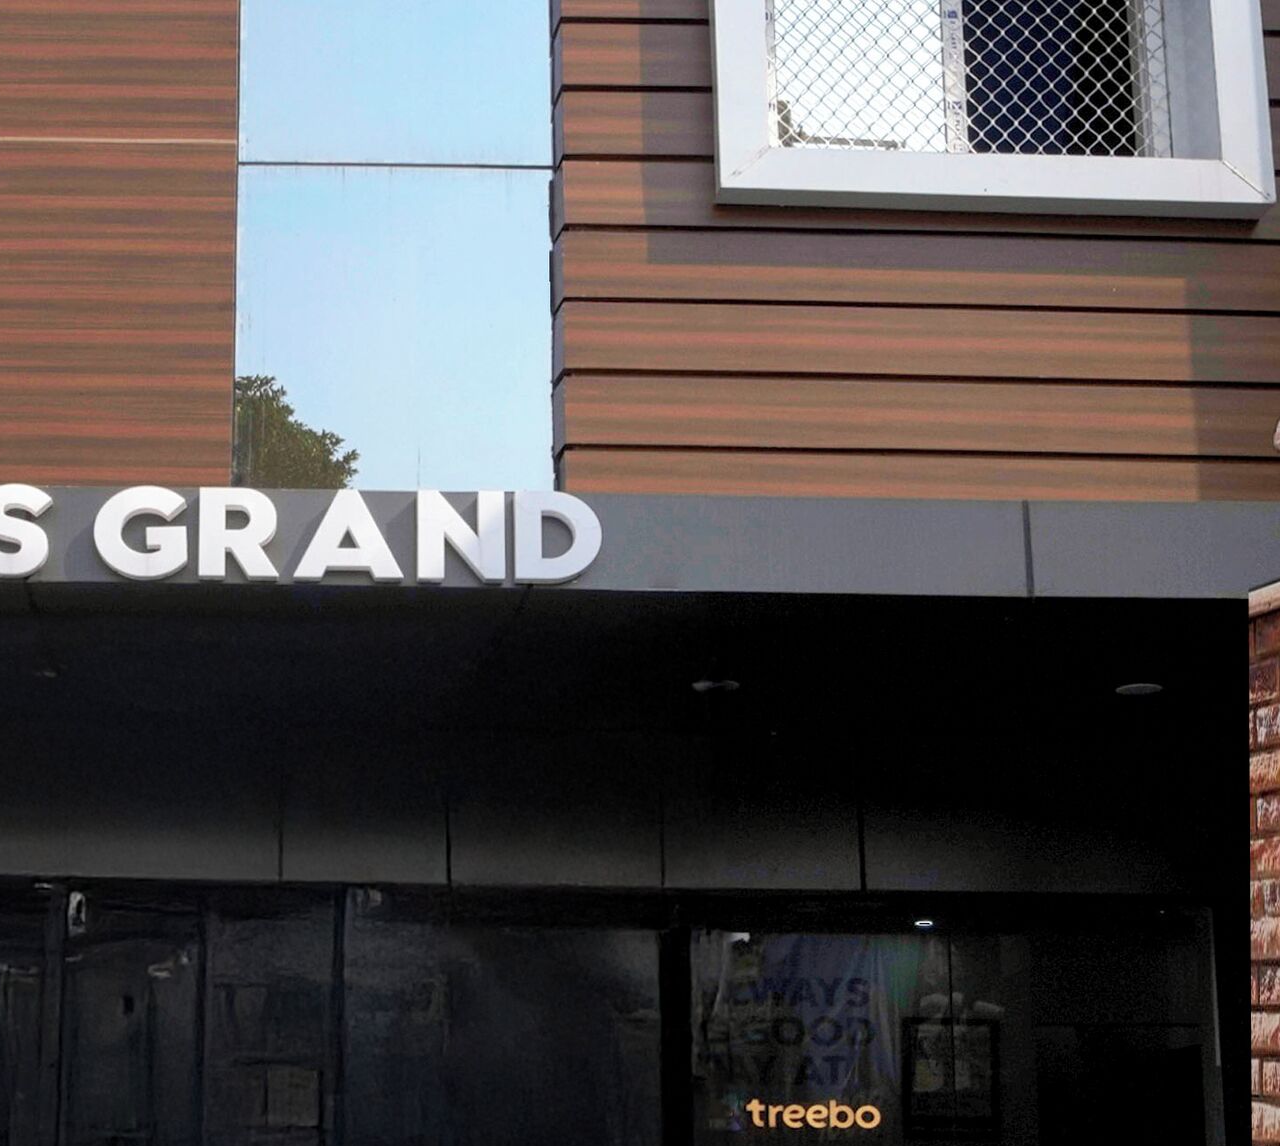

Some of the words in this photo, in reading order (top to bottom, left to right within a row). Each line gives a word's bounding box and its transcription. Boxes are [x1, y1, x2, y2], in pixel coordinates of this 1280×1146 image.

[93, 484, 603, 584] GRAND
[710, 977, 870, 1007] WAYS
[746, 1098, 881, 1129] treebo
